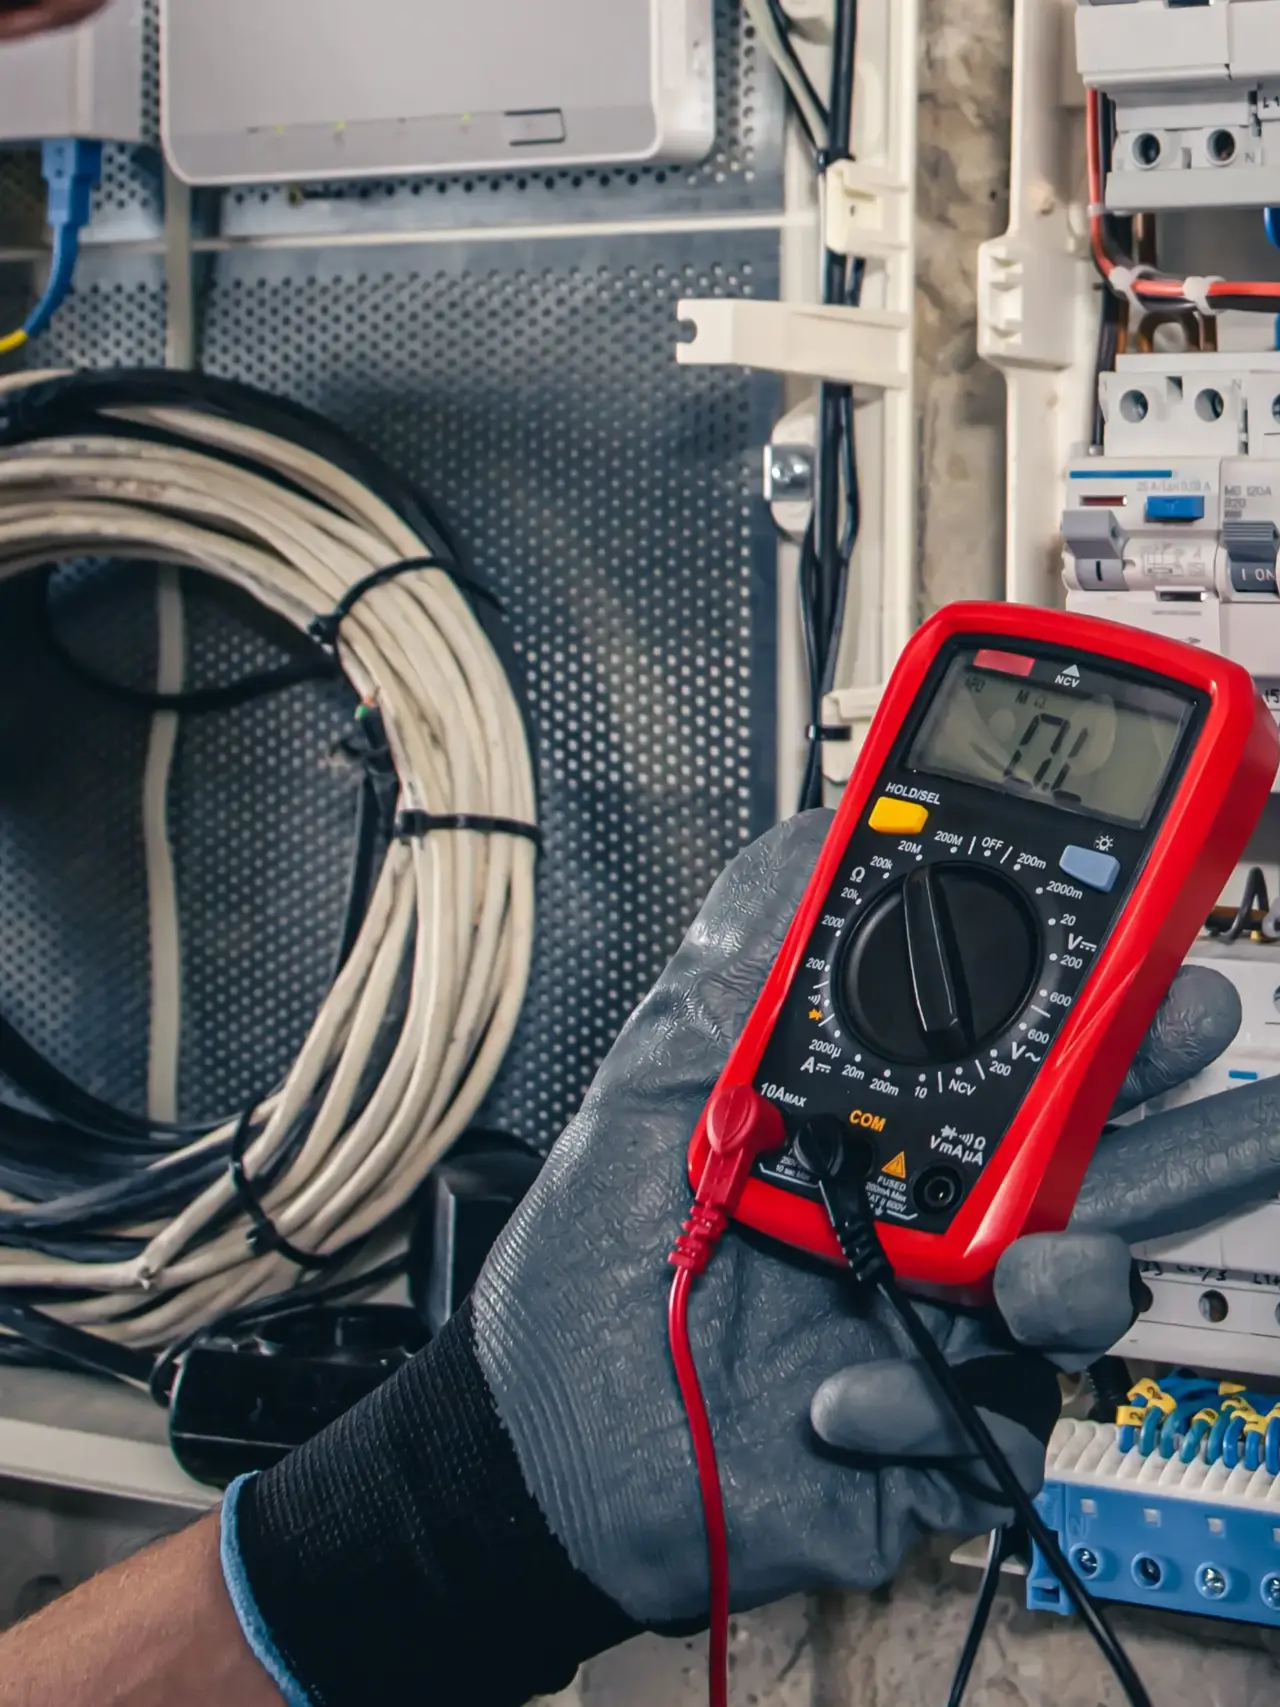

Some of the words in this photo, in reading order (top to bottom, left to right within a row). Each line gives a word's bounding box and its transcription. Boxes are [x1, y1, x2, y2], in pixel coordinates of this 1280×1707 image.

[1054, 674, 1080, 688] NCV
[885, 781, 941, 806] HOLD/SEL
[934, 830, 964, 847] 200M
[981, 836, 1005, 851] OFF
[897, 840, 923, 855] 20M
[869, 855, 894, 871] 200k
[1016, 852, 1047, 870] 200m
[840, 886, 860, 901] 20k
[1045, 880, 1083, 900] 2000m
[821, 914, 845, 928] 2000
[1060, 913, 1077, 927] 20
[805, 957, 826, 971] 200
[1060, 954, 1083, 970] 200
[1049, 991, 1073, 1007] 600
[1027, 1028, 1050, 1045] 600
[841, 1064, 866, 1081] 20m
[989, 1060, 1012, 1077] 200
[869, 1078, 900, 1097] 200m
[914, 1085, 928, 1100] 10
[948, 1078, 977, 1097] NCV
[849, 1109, 887, 1133] COM
[877, 1175, 908, 1193] FUSED
